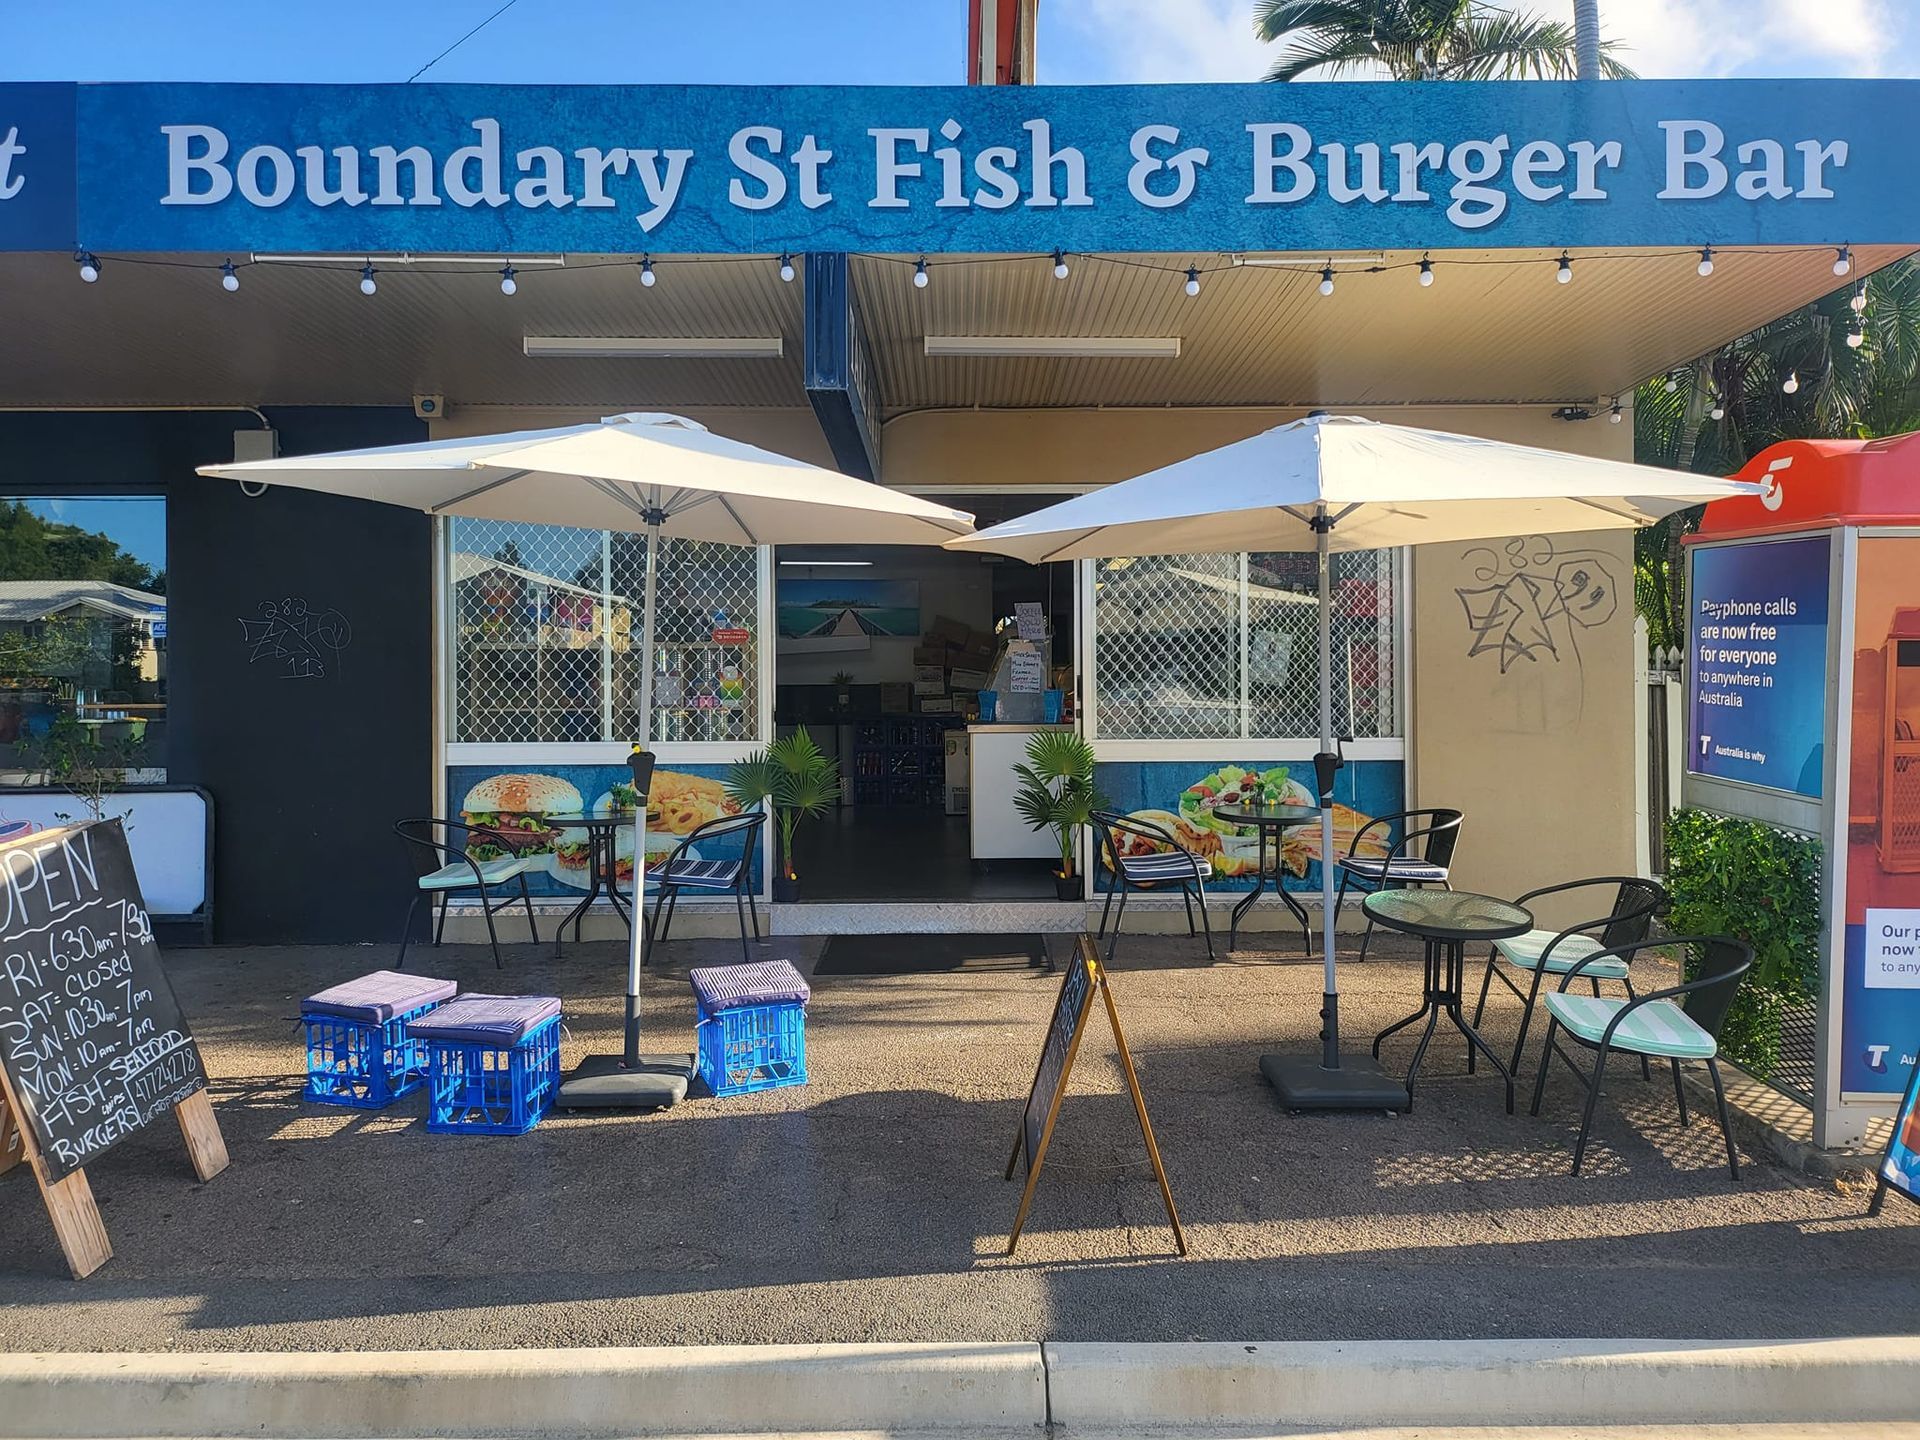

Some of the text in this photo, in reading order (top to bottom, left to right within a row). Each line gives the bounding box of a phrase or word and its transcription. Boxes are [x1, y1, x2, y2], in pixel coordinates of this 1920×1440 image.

[160, 118, 1848, 233] Boundary St Fish & Burger Bar
[1701, 597, 1797, 620] Payphone calls
[1700, 622, 1777, 640] are now free
[1700, 645, 1777, 669] for everyone
[1699, 670, 1773, 688] to anywhere in
[1698, 690, 1743, 707] Australia
[1700, 735, 1711, 755] T
[1715, 744, 1766, 765] Australia is why
[1882, 924, 1911, 938] Our
[1882, 945, 1915, 955] now
[1881, 962, 1895, 972] to
[110, 1030, 184, 1081] SEAFOOD
[1868, 1045, 1890, 1067] T
[135, 1048, 197, 1102] 47724278
